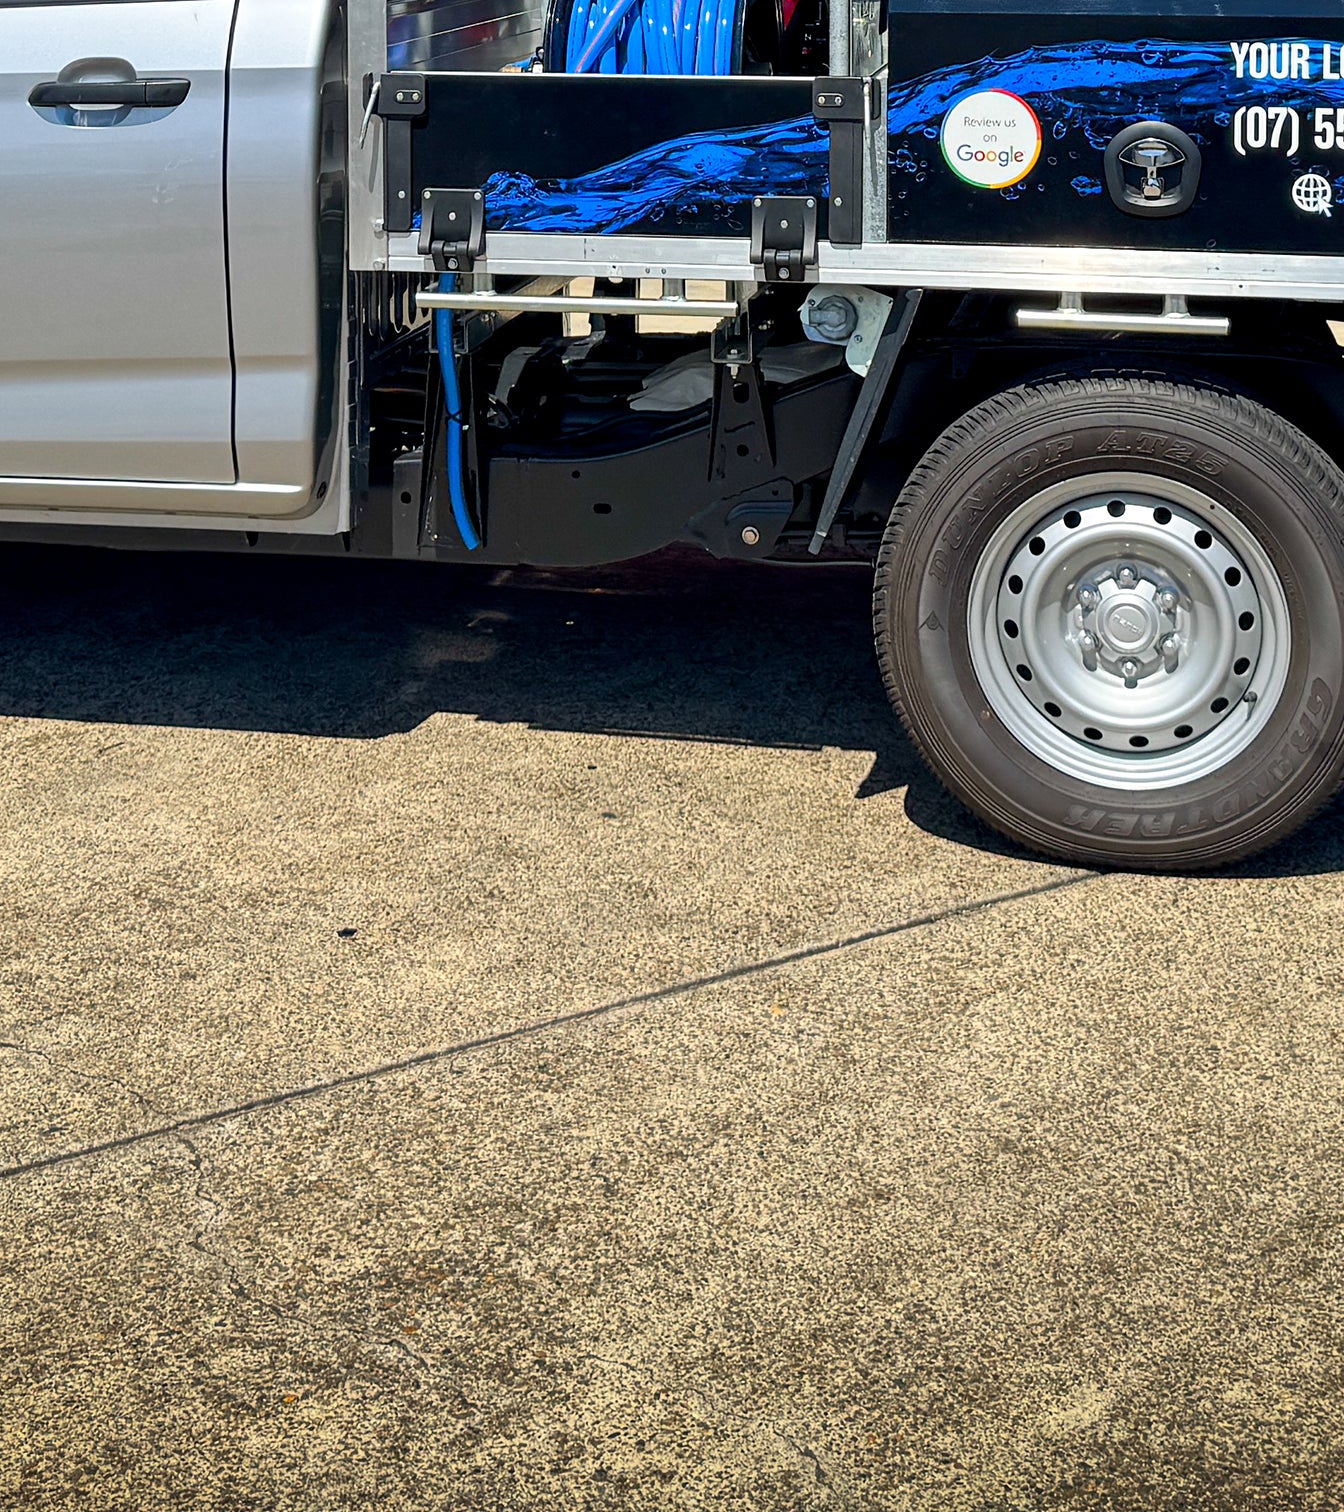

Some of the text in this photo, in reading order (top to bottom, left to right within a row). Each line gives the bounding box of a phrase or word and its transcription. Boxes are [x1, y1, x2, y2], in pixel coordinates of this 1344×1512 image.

[1230, 42, 1310, 80] YOUR
[964, 116, 1017, 128] Review us
[1233, 106, 1300, 157] (07)
[983, 134, 997, 143] on
[956, 144, 1024, 167] Google
[927, 430, 1231, 586] DUNLOP AT25
